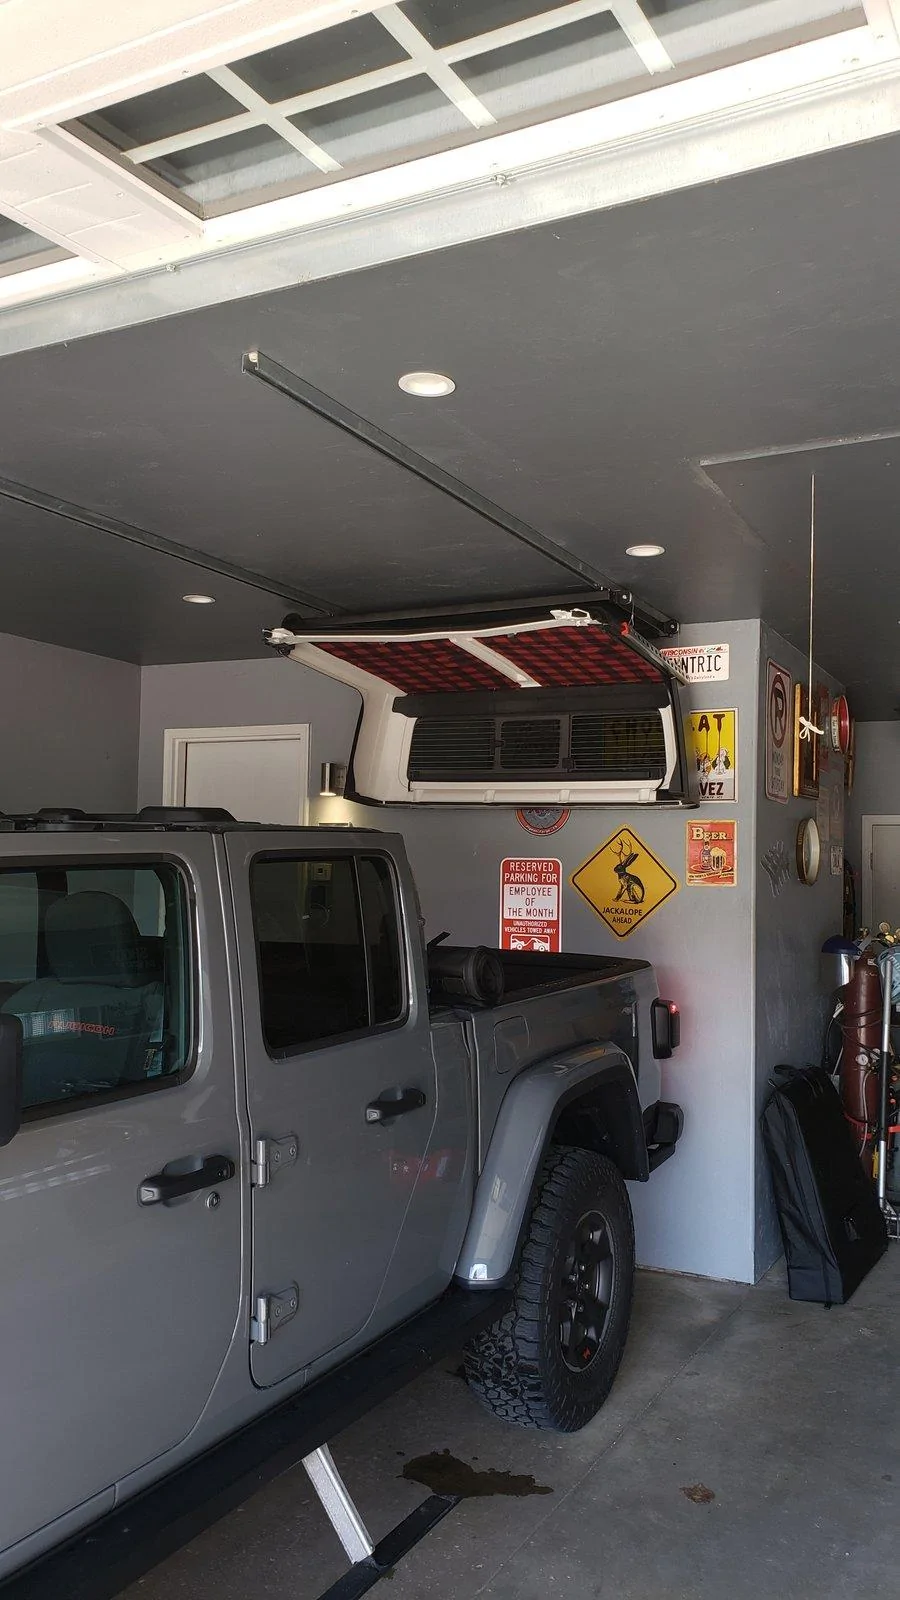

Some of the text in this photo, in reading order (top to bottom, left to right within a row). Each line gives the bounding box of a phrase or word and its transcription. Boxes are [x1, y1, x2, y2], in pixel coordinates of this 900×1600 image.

[692, 714, 726, 732] AT
[699, 782, 724, 796] VEZ
[509, 861, 554, 872] RESERVED
[504, 872, 558, 883] PARKING FOR
[509, 886, 552, 897] EMPLOYEE
[525, 897, 536, 907] OF
[508, 907, 554, 918] THE MONTH
[602, 906, 643, 917] JACKALOPE
[611, 916, 633, 924] AHEAD
